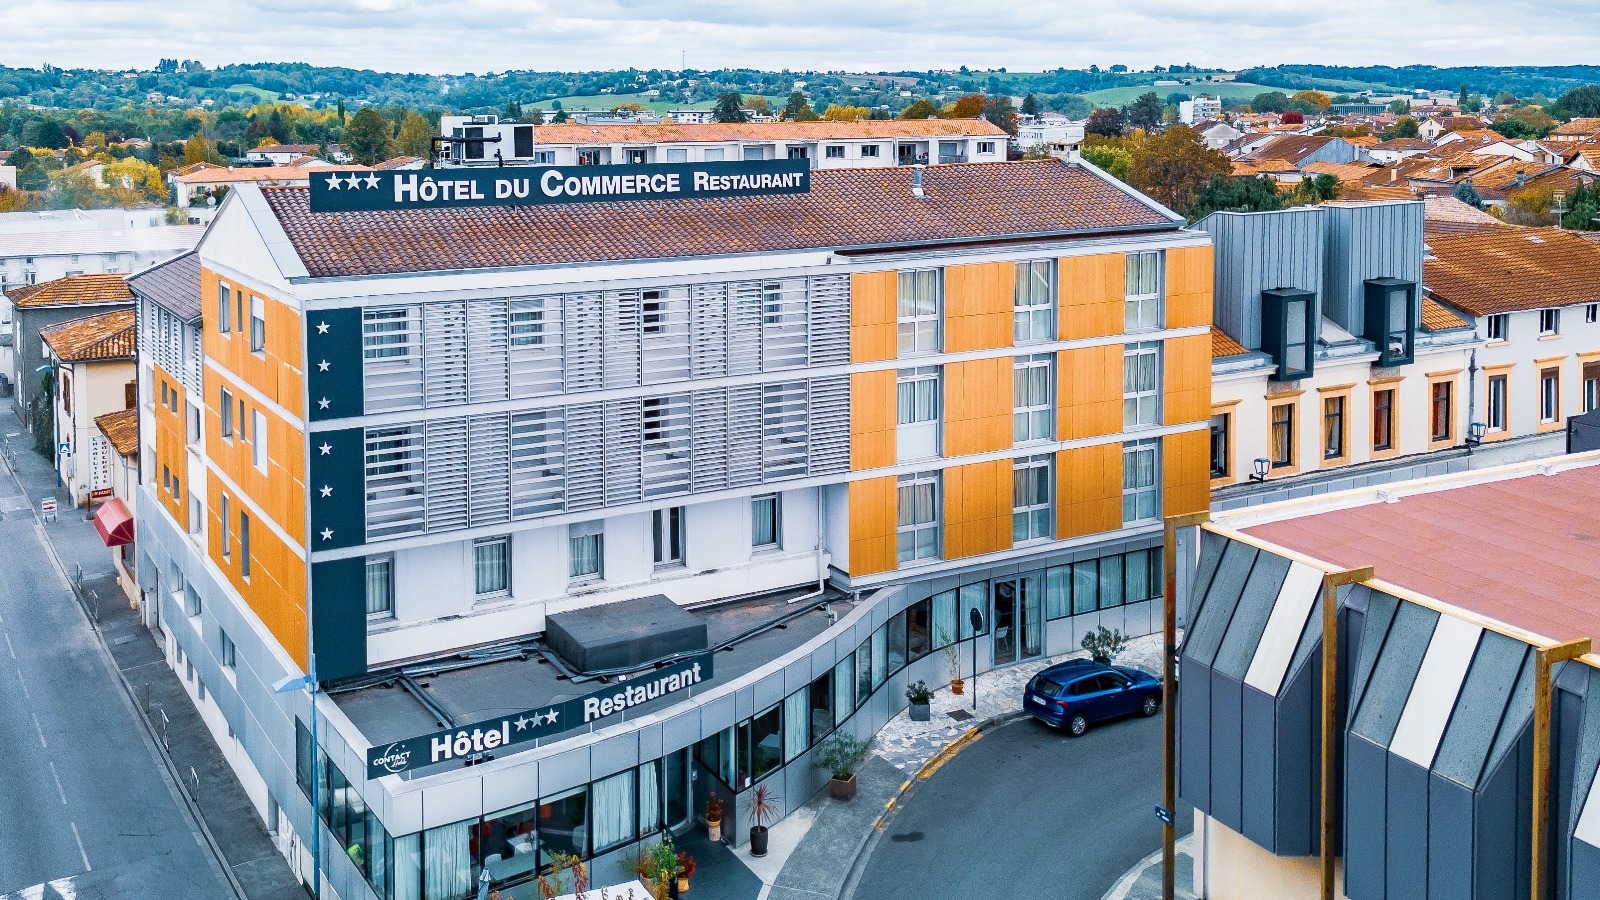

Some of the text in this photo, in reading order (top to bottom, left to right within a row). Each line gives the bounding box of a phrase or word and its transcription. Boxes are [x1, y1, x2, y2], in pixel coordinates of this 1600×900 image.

[394, 170, 804, 203] HÔTEL DU COMMERCE RESTAURANT
[431, 663, 701, 762] Hôtel Restaurant
[373, 751, 411, 766] CONTACT
